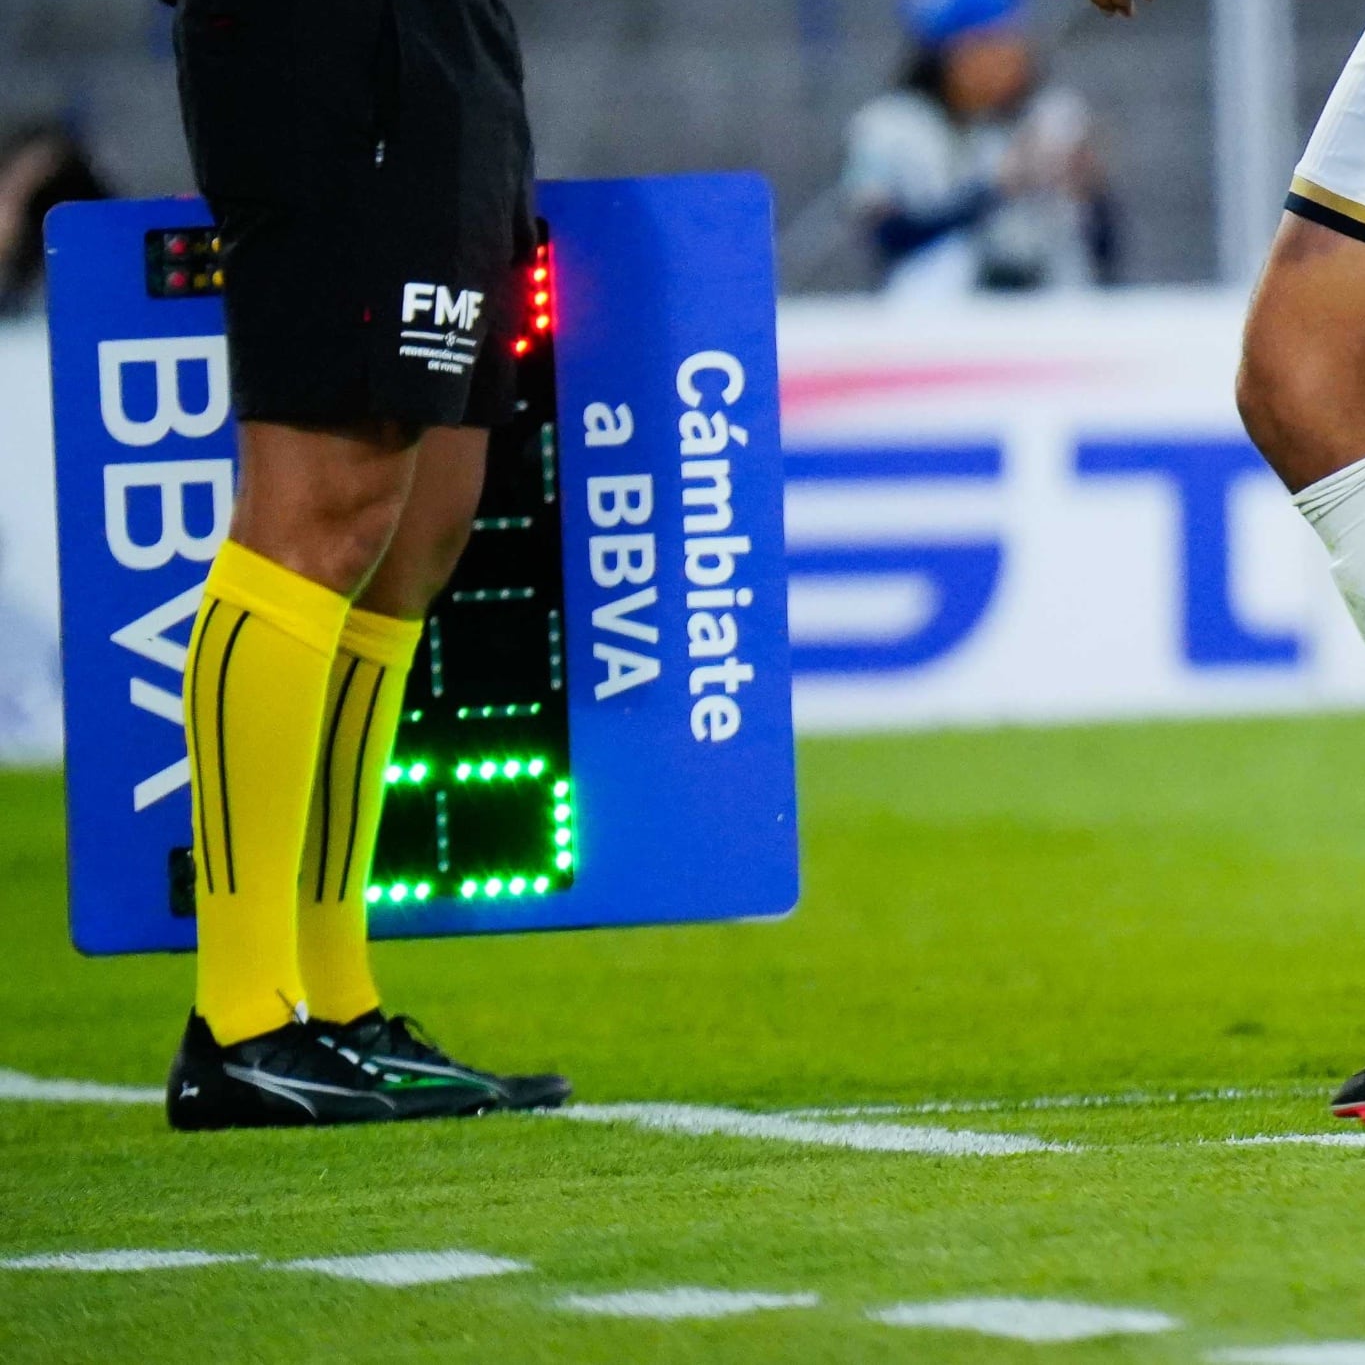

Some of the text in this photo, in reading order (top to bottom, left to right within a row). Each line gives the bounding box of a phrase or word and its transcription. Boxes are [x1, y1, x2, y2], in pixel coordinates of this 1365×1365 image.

[401, 282, 484, 331] FMF
[583, 402, 661, 700] a BBVA
[675, 350, 754, 742] Cámbiate
